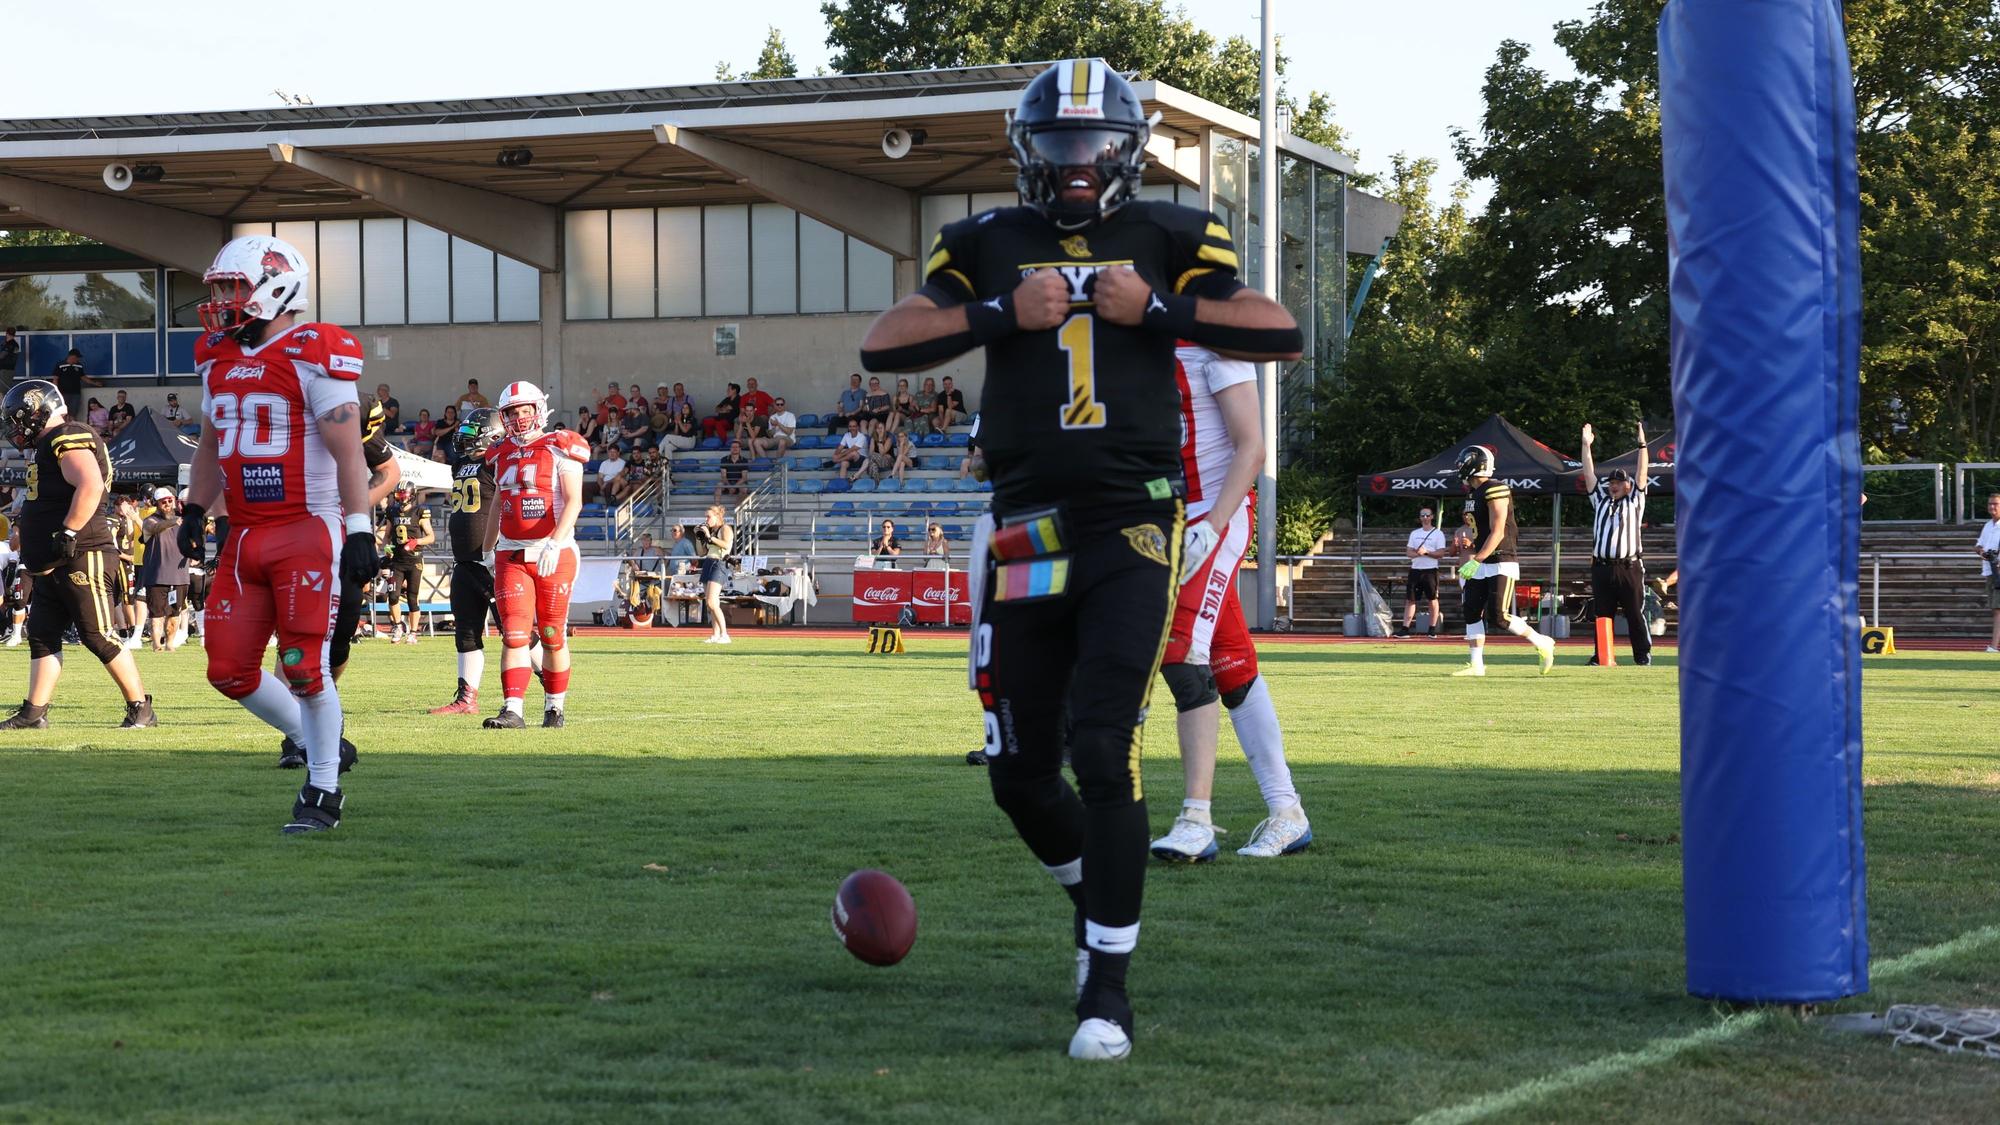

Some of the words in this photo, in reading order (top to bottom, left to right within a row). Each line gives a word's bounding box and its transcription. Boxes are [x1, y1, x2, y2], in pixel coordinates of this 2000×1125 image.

[1058, 313, 1107, 430] 1
[211, 392, 291, 459] 90
[120, 471, 160, 480] XLMOTO
[243, 466, 281, 478] brink
[244, 478, 282, 486] mann
[499, 463, 539, 497] 41
[1391, 478, 1448, 490] 24MX
[1490, 478, 1542, 489] 4MX
[450, 477, 481, 513] 60
[522, 498, 545, 506] brink
[395, 525, 408, 545] 9
[1200, 568, 1228, 624] DEVILS
[869, 629, 896, 655] 10
[1862, 630, 1886, 654] G
